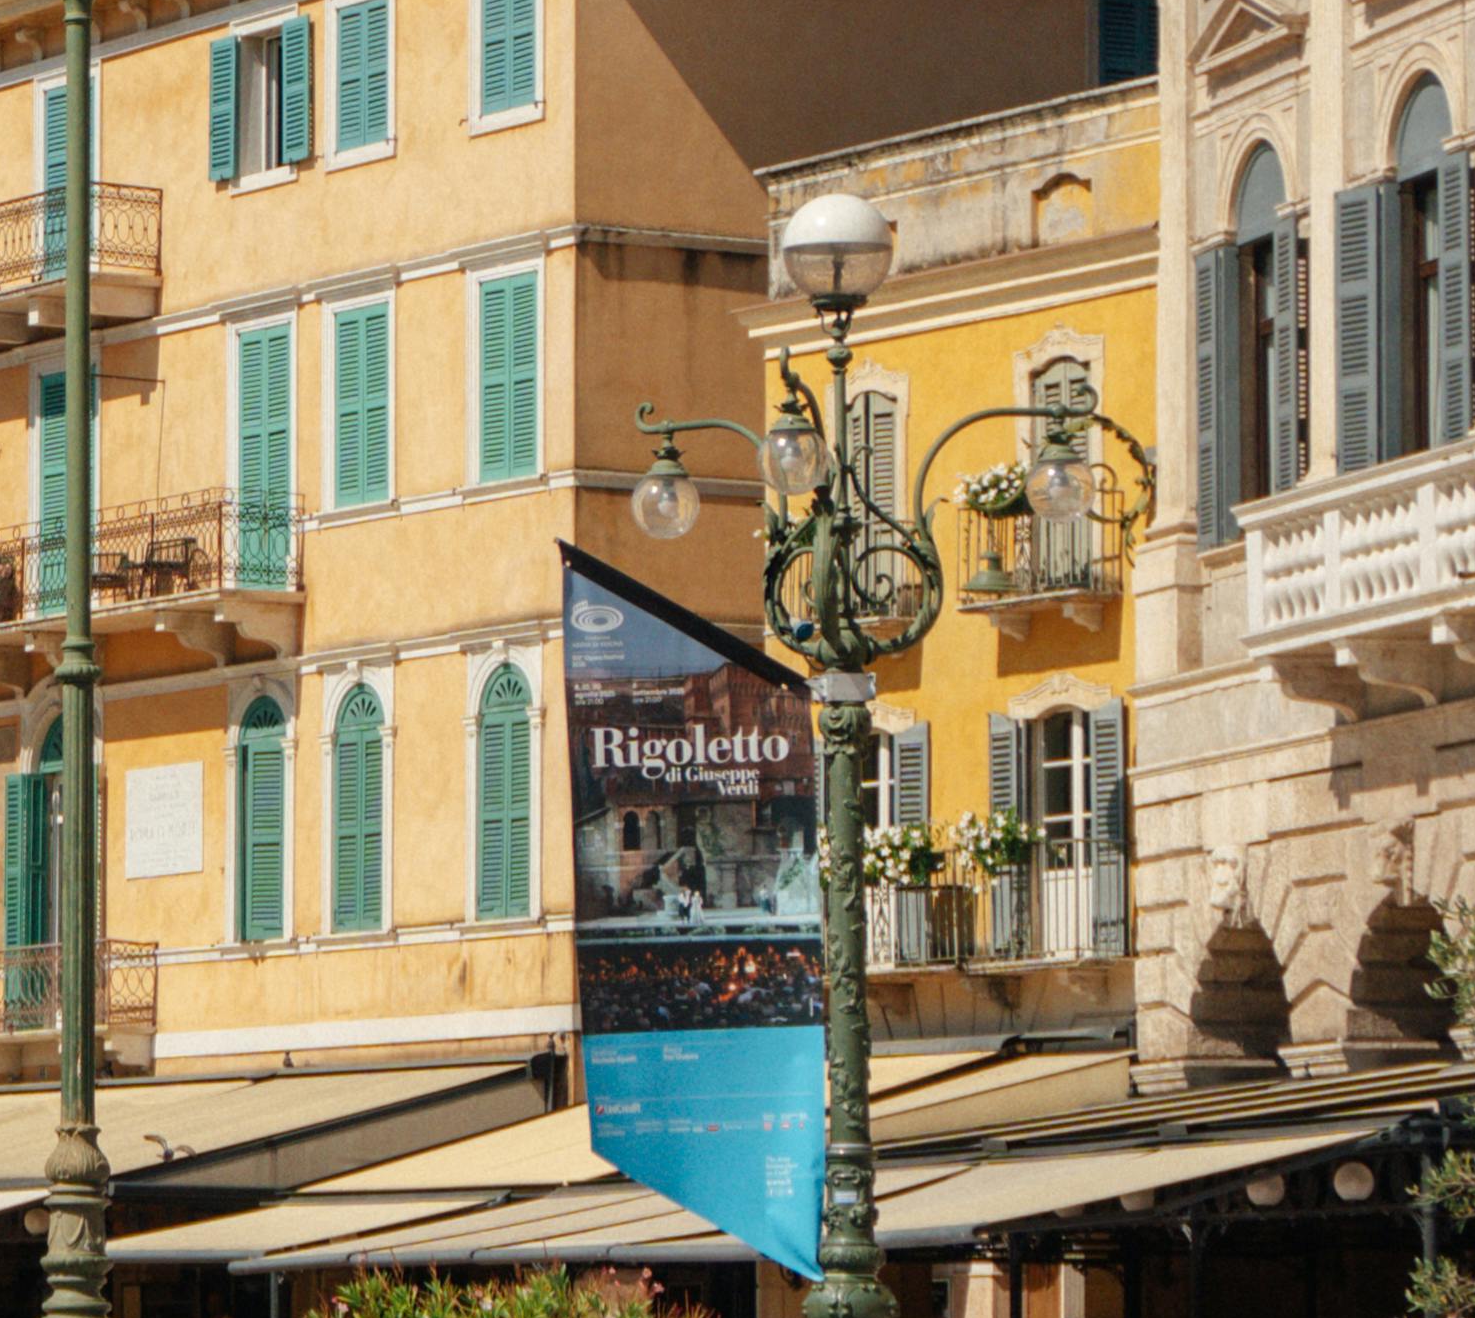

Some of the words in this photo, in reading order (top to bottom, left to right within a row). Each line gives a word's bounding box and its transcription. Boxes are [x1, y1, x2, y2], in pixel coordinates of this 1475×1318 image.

[591, 724, 789, 780] Rigoletto
[665, 766, 682, 782] di
[685, 765, 760, 784] Giuseppe
[717, 779, 760, 796] Verdi
